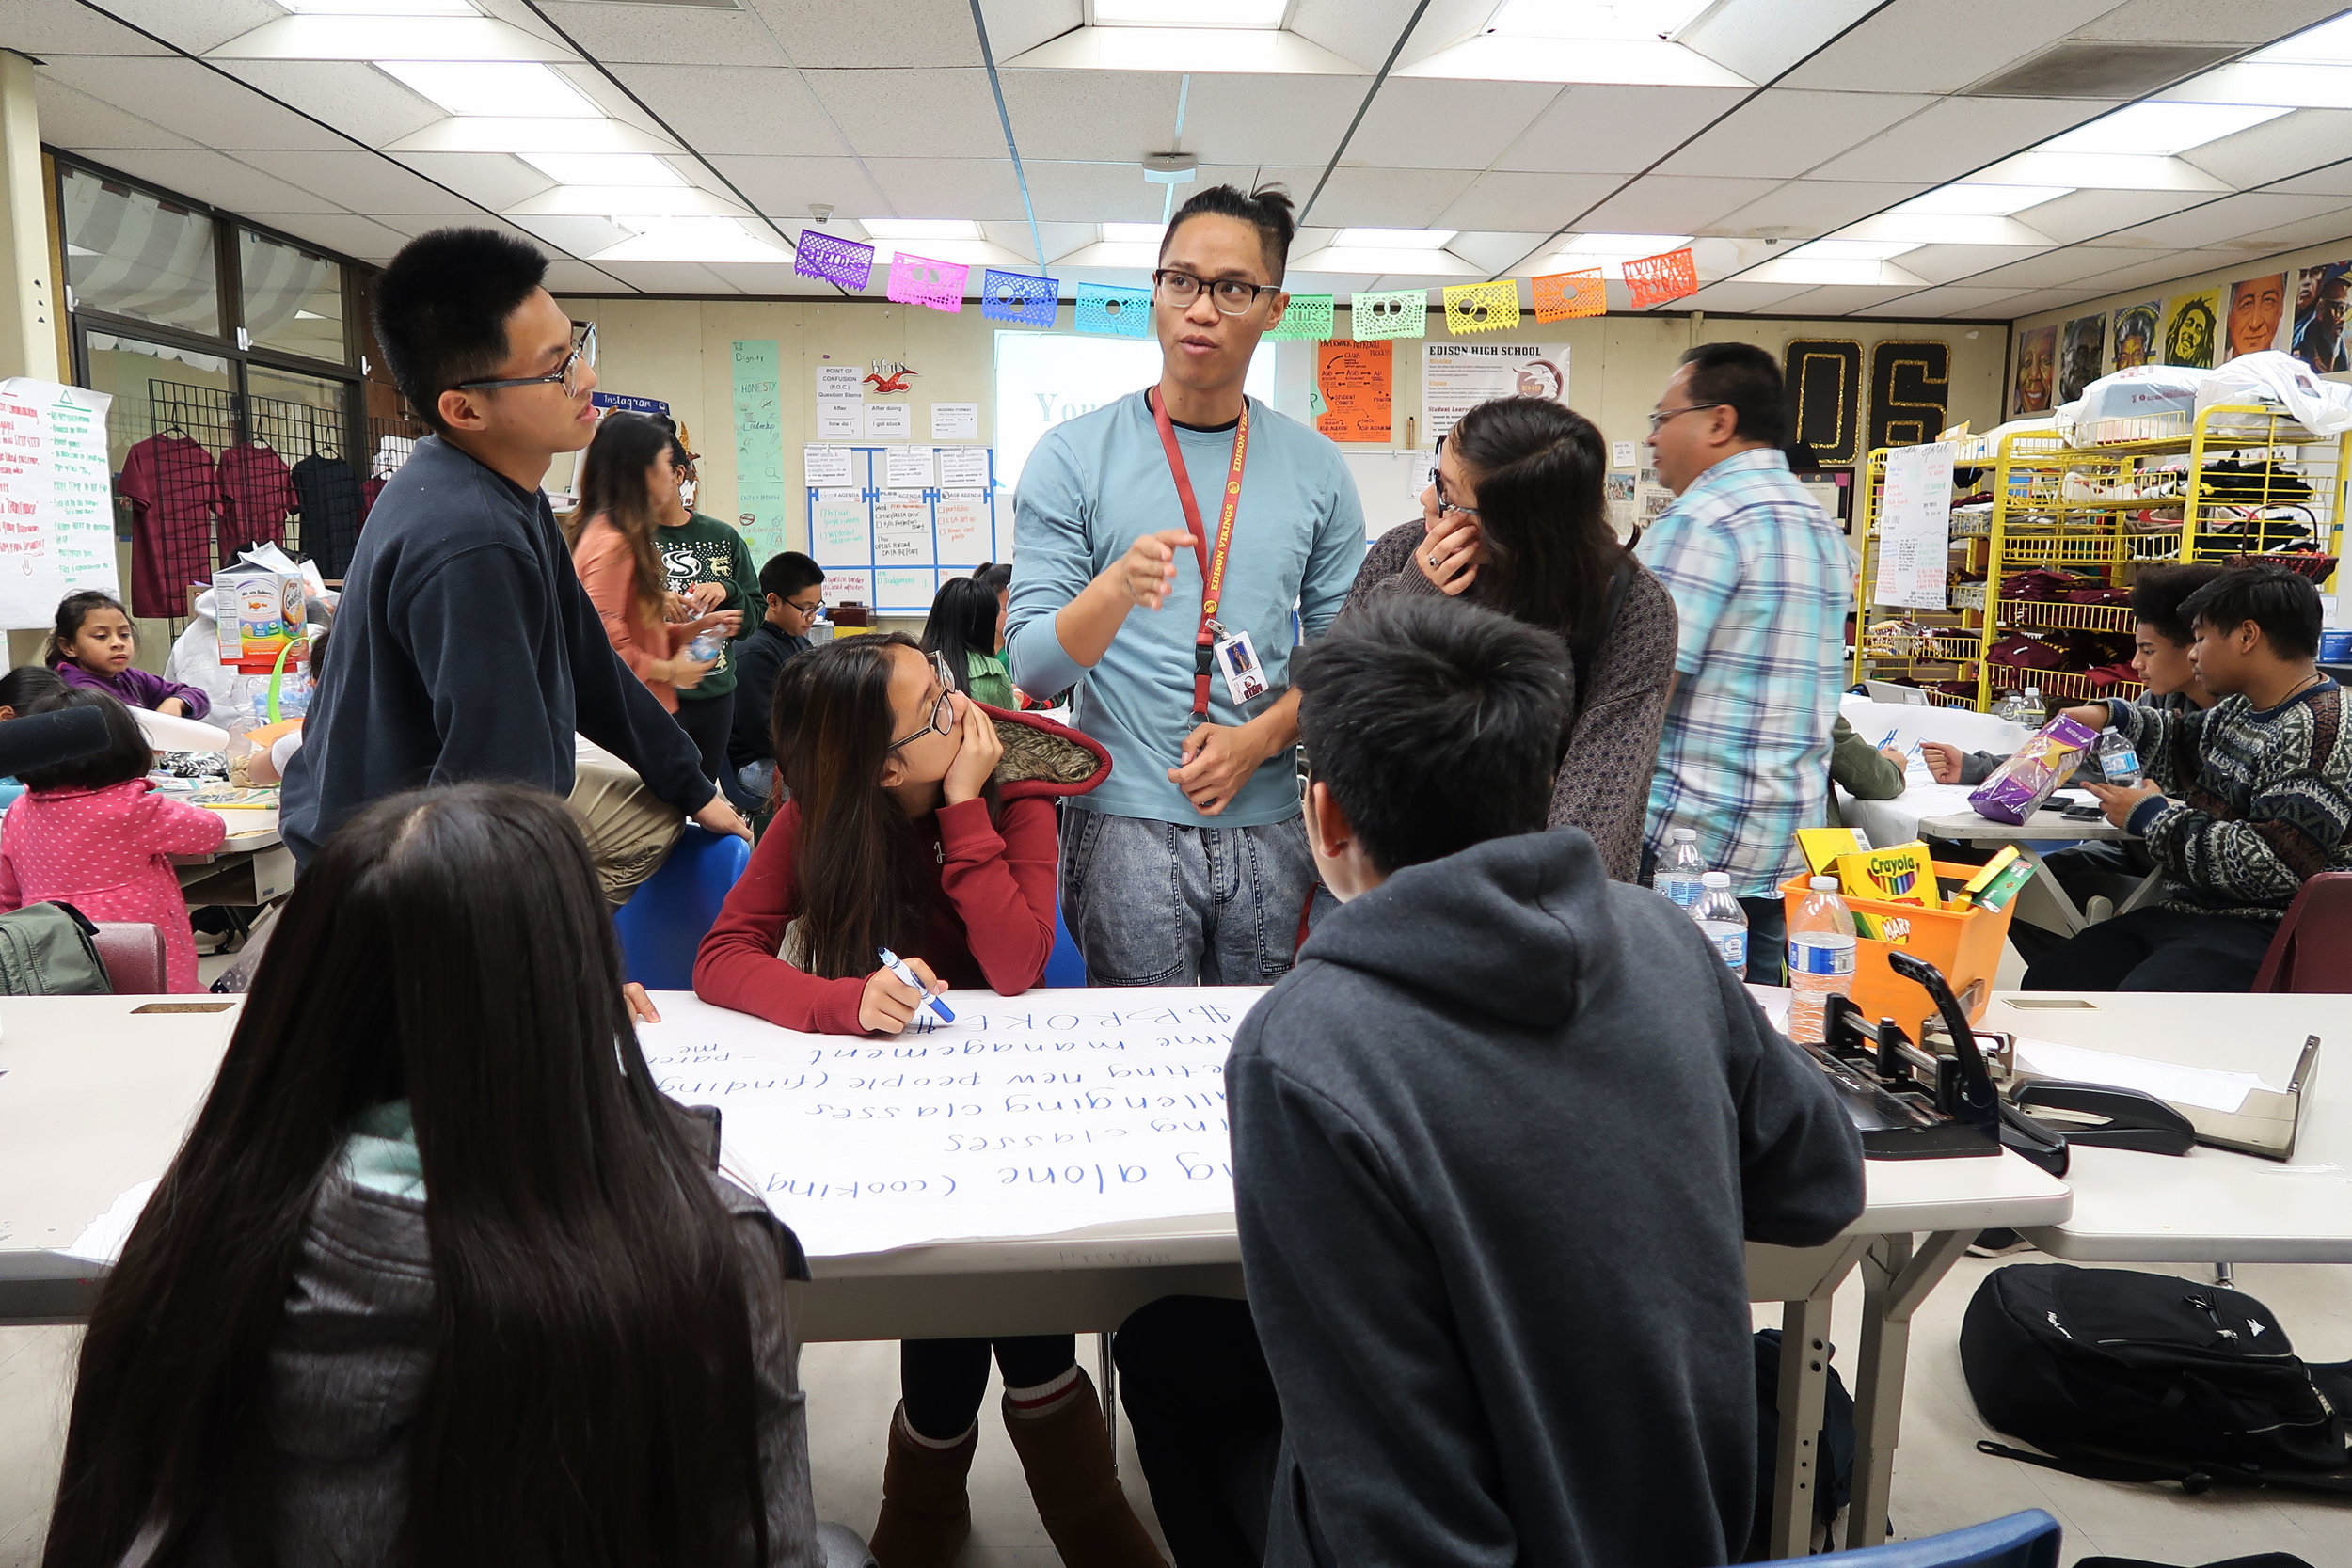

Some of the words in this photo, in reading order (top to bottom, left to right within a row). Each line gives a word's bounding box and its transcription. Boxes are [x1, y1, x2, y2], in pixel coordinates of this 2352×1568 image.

[1429, 345, 1468, 356] EDISON
[1471, 346, 1498, 356] HIGH
[1501, 346, 1541, 356] SCHOOL
[741, 381, 776, 394] HONESTY
[603, 394, 651, 410] Instagram
[1232, 434, 1246, 472] EDISON
[1211, 550, 1225, 592] EDISON
[1218, 503, 1234, 547] VIKINGS
[1870, 854, 1915, 879] Crayola
[849, 1071, 981, 1091] people
[1006, 1072, 1083, 1085] new
[804, 1102, 983, 1118] classes
[944, 1129, 1128, 1153] classes
[996, 1164, 1148, 1195] alone
